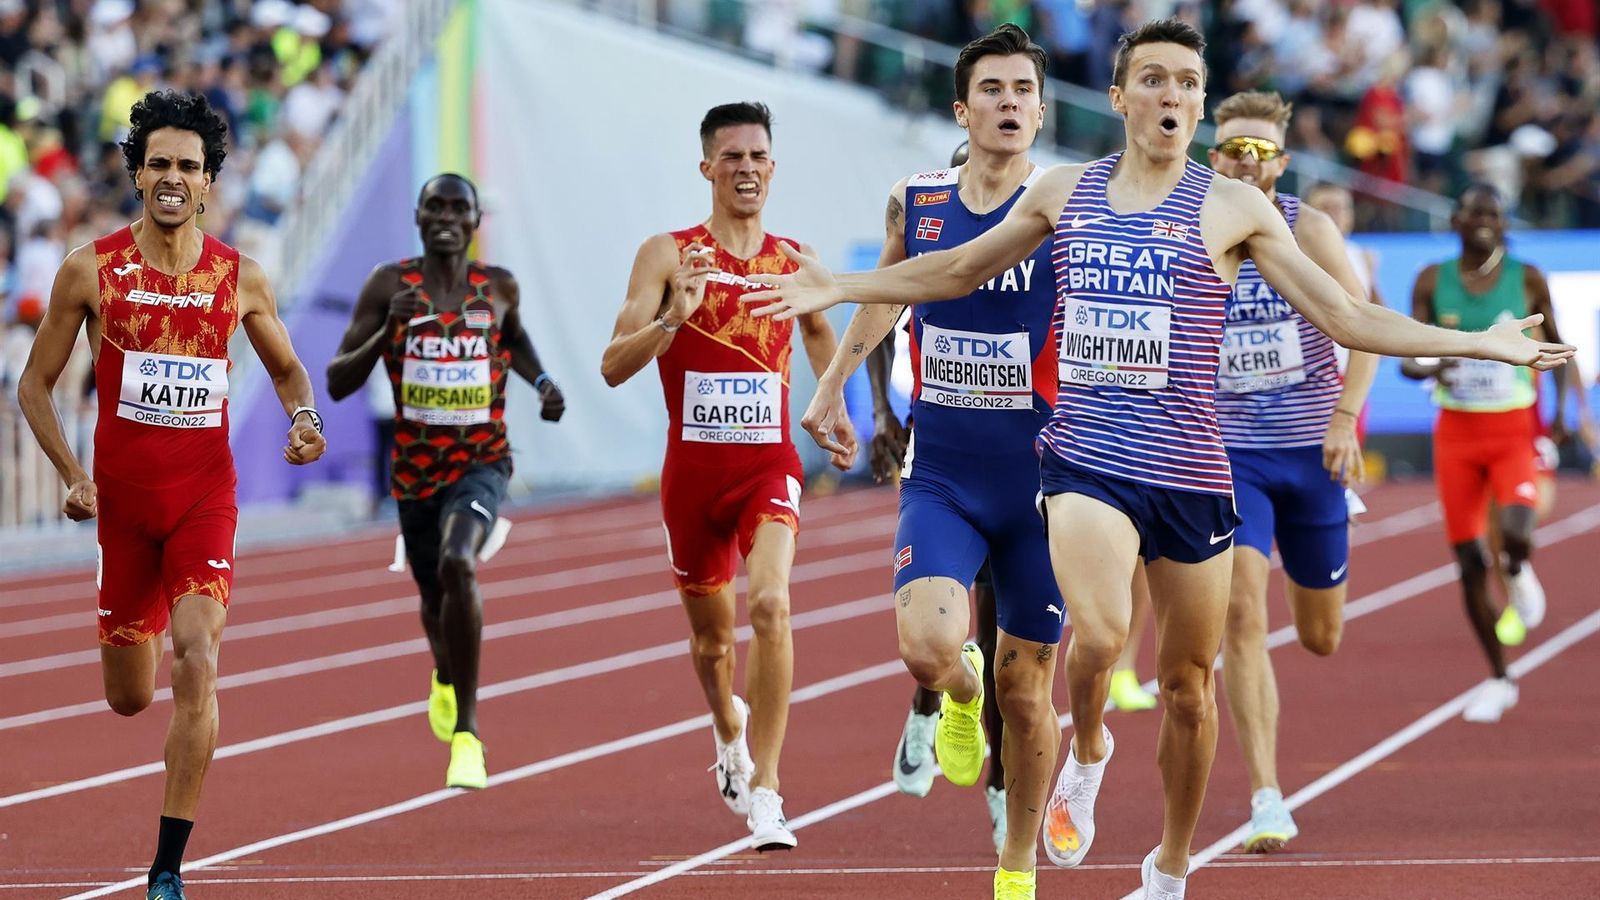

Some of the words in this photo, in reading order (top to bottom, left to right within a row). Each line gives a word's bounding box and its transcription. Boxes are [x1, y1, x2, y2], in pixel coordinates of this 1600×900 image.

[1068, 242, 1178, 271] GREAT
[1068, 267, 1174, 297] BRITAIN
[125, 289, 215, 308] ESPAÑA
[1089, 307, 1151, 331] TDK
[1229, 301, 1293, 320] ITAIN
[405, 335, 488, 358] KENYA
[950, 336, 1014, 359] TDK
[1066, 331, 1162, 364] WIGHTMAN
[1233, 328, 1283, 347] TDK
[159, 359, 213, 382] TDK
[925, 355, 1027, 387] INGEBRIGTSEN
[1227, 350, 1281, 373] KERR
[431, 367, 476, 381] TDK
[1071, 368, 1147, 385] OREGON22
[140, 382, 210, 407] KATIR
[407, 384, 485, 405] KIPSANG
[714, 378, 768, 395] TDK
[936, 392, 1013, 408] OREGON22
[135, 410, 206, 426] OREGON22
[693, 401, 772, 424] GARCÍA
